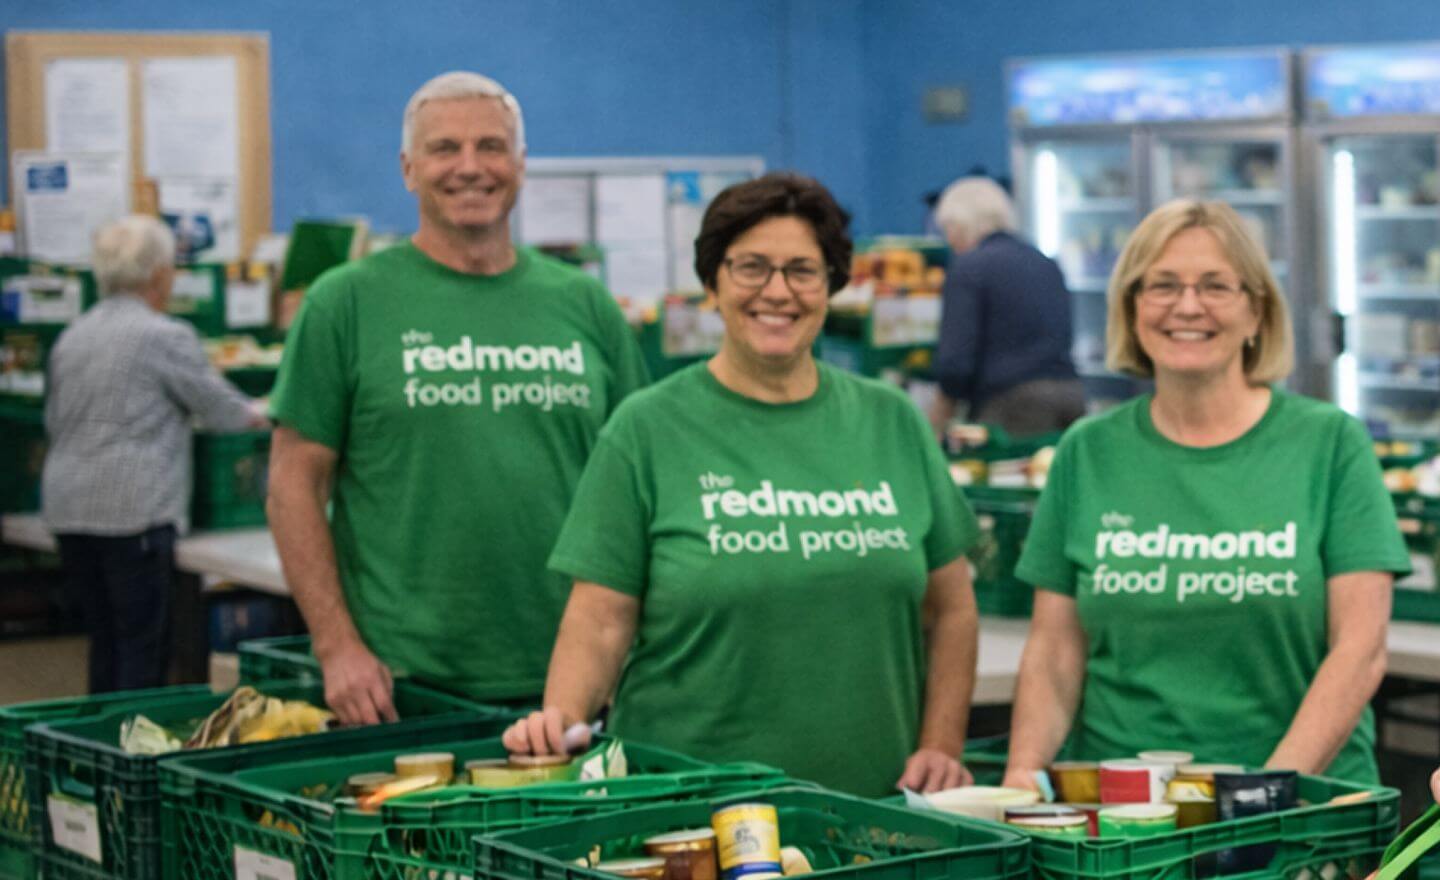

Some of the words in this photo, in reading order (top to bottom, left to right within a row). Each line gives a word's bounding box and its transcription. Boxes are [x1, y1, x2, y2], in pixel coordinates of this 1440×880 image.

[403, 335, 585, 375] redmond
[404, 376, 482, 408] food
[700, 480, 898, 520] redmond
[706, 521, 790, 555] food
[799, 522, 911, 560] project
[1095, 520, 1297, 561] redmond
[1092, 563, 1169, 595] food
[1176, 566, 1299, 603] project
